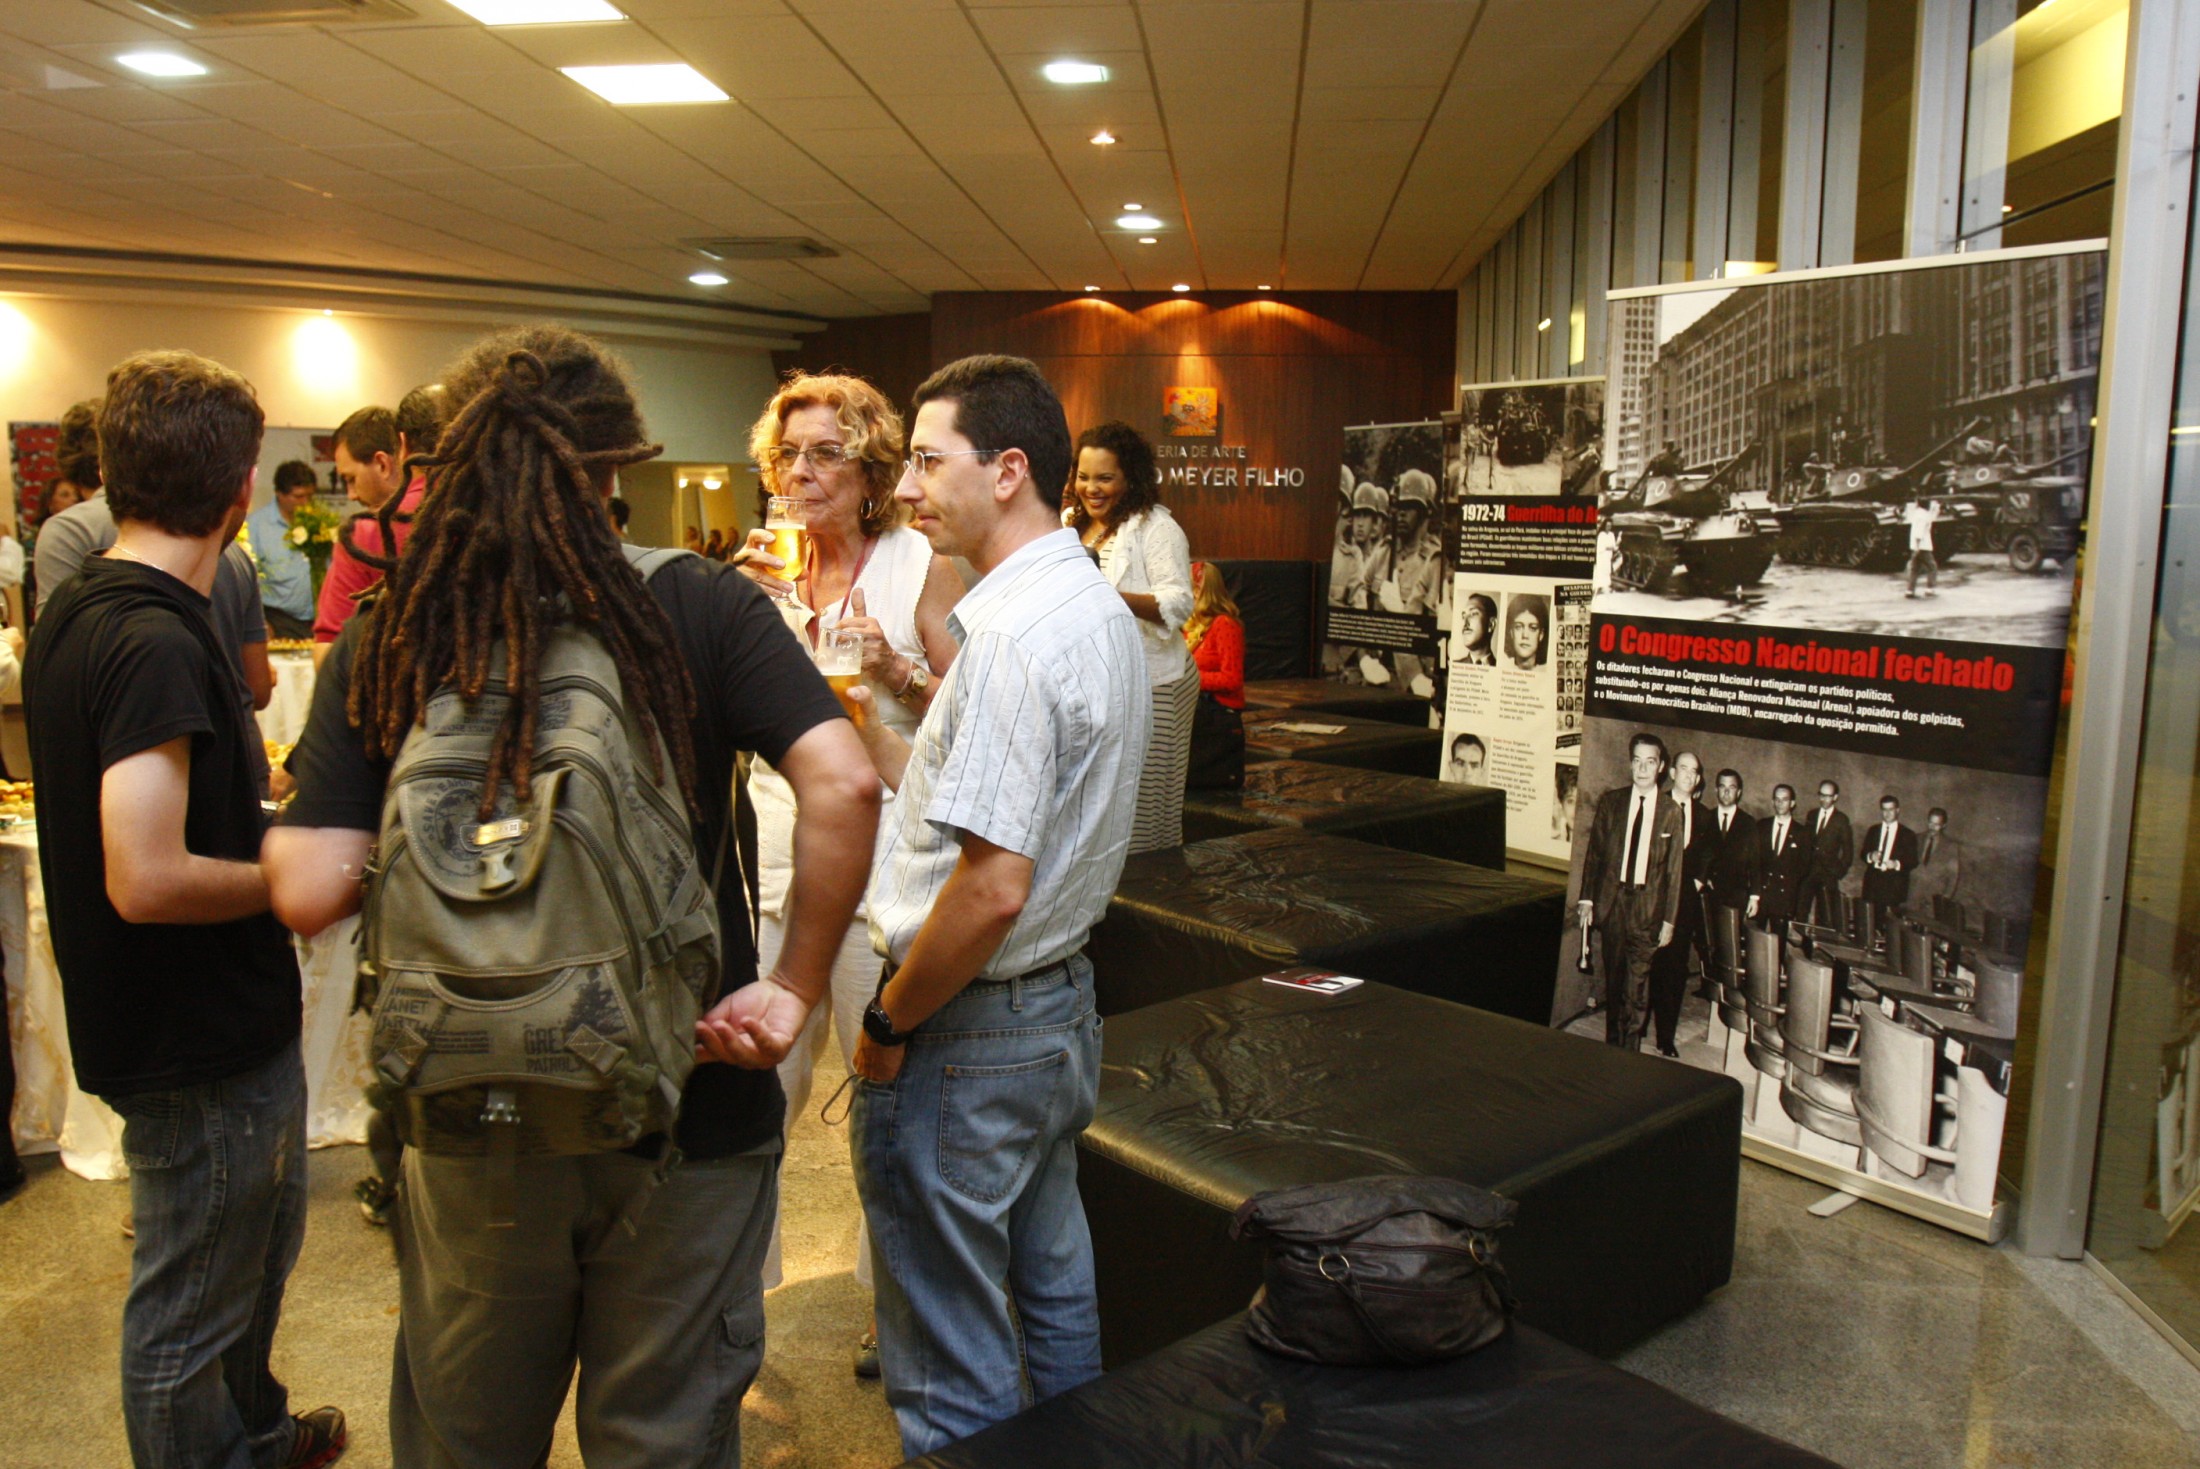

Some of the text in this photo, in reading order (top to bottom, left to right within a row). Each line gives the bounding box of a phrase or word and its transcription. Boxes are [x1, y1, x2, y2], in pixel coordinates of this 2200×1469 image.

[1191, 445, 1208, 458] DE
[1211, 445, 1246, 459] ARTE
[1168, 467, 1238, 487] MEYER
[1244, 467, 1305, 487] FILHO
[1462, 504, 1506, 521] 1972-74
[1507, 504, 1565, 522] Guerrilha
[1567, 505, 1584, 523] do
[1600, 624, 2014, 691] O Congresso Nacional fechado
[1595, 675, 1965, 729] substituindo-os por apenas dois: Aliança Renovadora Nacional (Arena), apoiadora dos golpistas,
[1596, 660, 1605, 671] Os
[1606, 661, 1640, 674] ditadores
[1642, 664, 1675, 678] fecharam
[1682, 669, 1718, 683] Congresso
[1719, 673, 1753, 687] Nacional
[1754, 679, 1759, 687] e
[1760, 679, 1806, 692] extinguiram
[1808, 684, 1818, 694] os
[1819, 685, 1854, 698] partidos
[1855, 689, 1895, 704] políticos,
[1593, 689, 1900, 736] e o Movimento Democrático Brasileiro (MDB), encarregado da oposição permitida.
